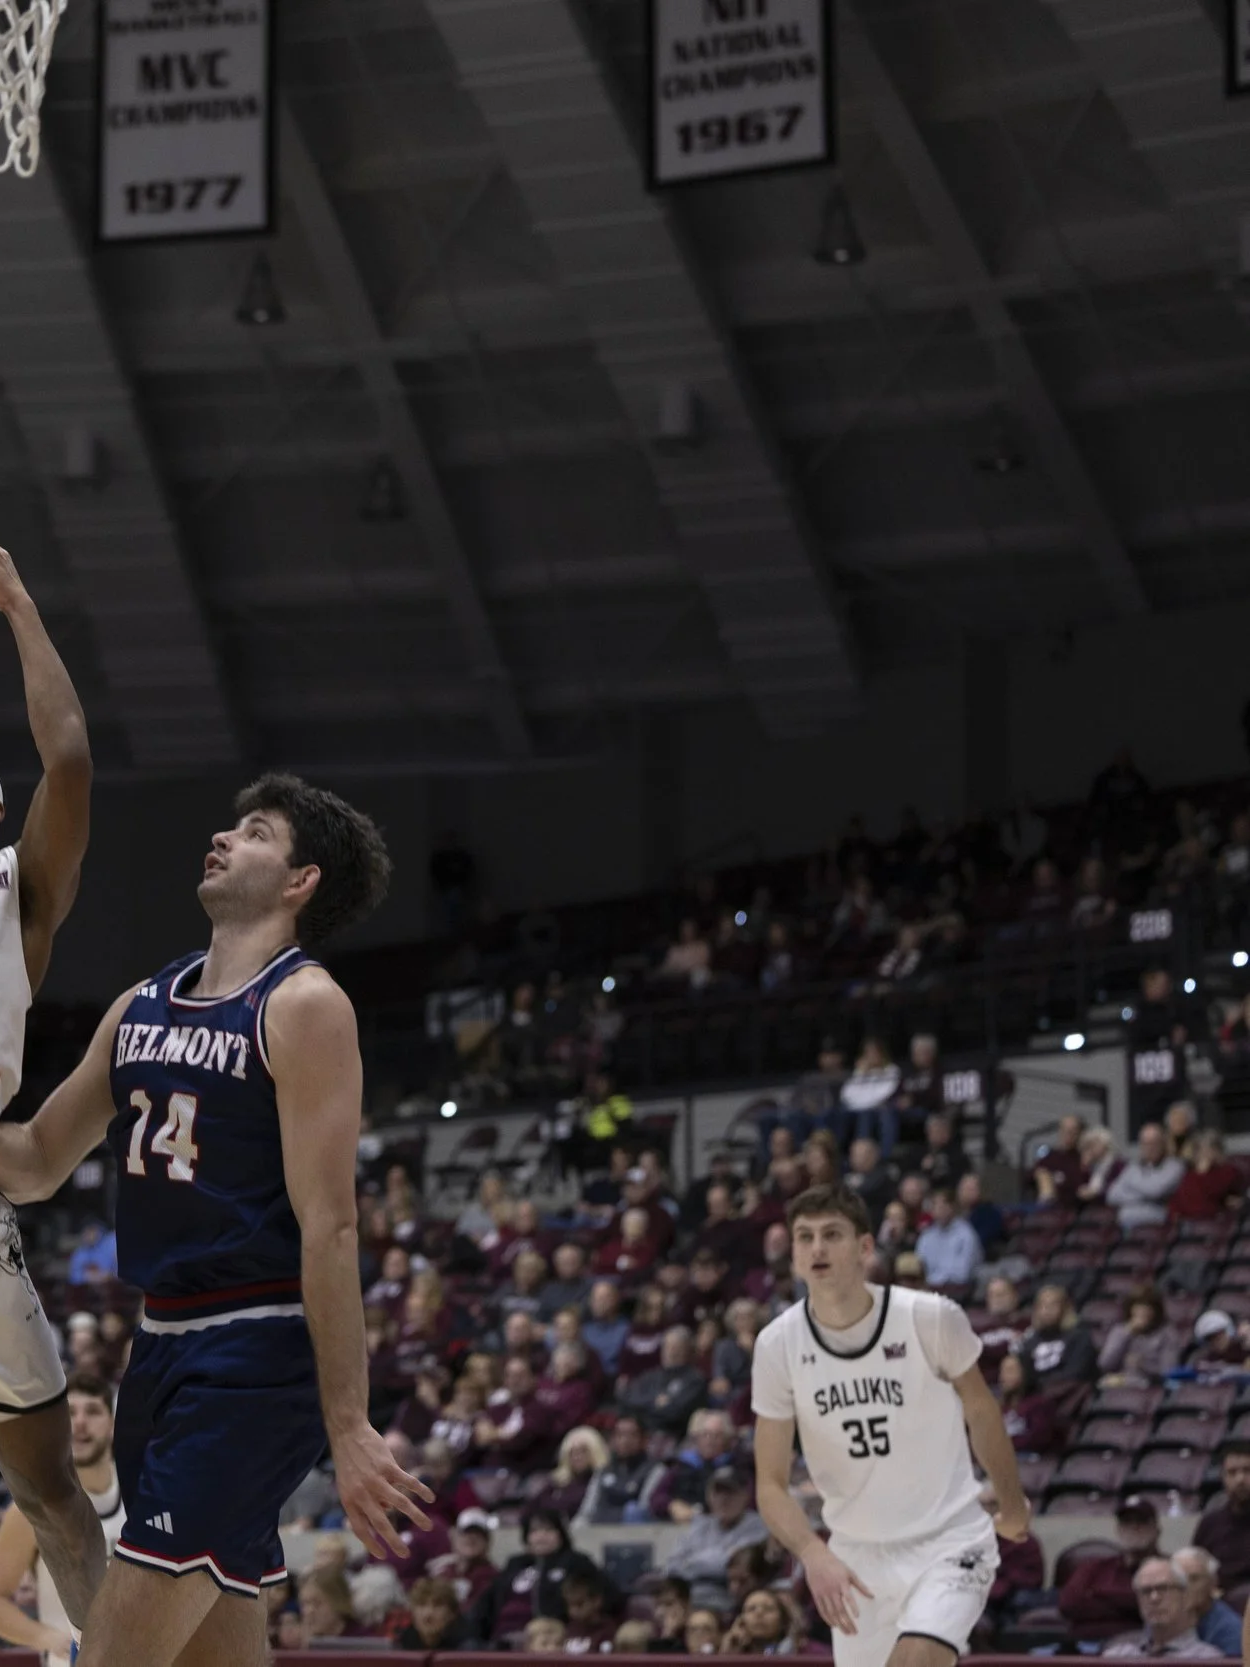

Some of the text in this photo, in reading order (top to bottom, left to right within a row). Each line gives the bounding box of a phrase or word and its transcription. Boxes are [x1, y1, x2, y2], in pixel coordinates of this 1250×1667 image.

[672, 22, 802, 63] NATIONAL
[136, 47, 232, 93] MVC
[659, 54, 817, 101] CHAMPIONS
[108, 95, 259, 131] CHAMPIONS
[676, 103, 806, 157] 1967
[123, 172, 245, 216] 1977
[115, 1022, 251, 1081] BELMONT
[125, 1087, 200, 1184] 14
[813, 1376, 905, 1417] SALUKIS
[841, 1414, 891, 1460] 35
